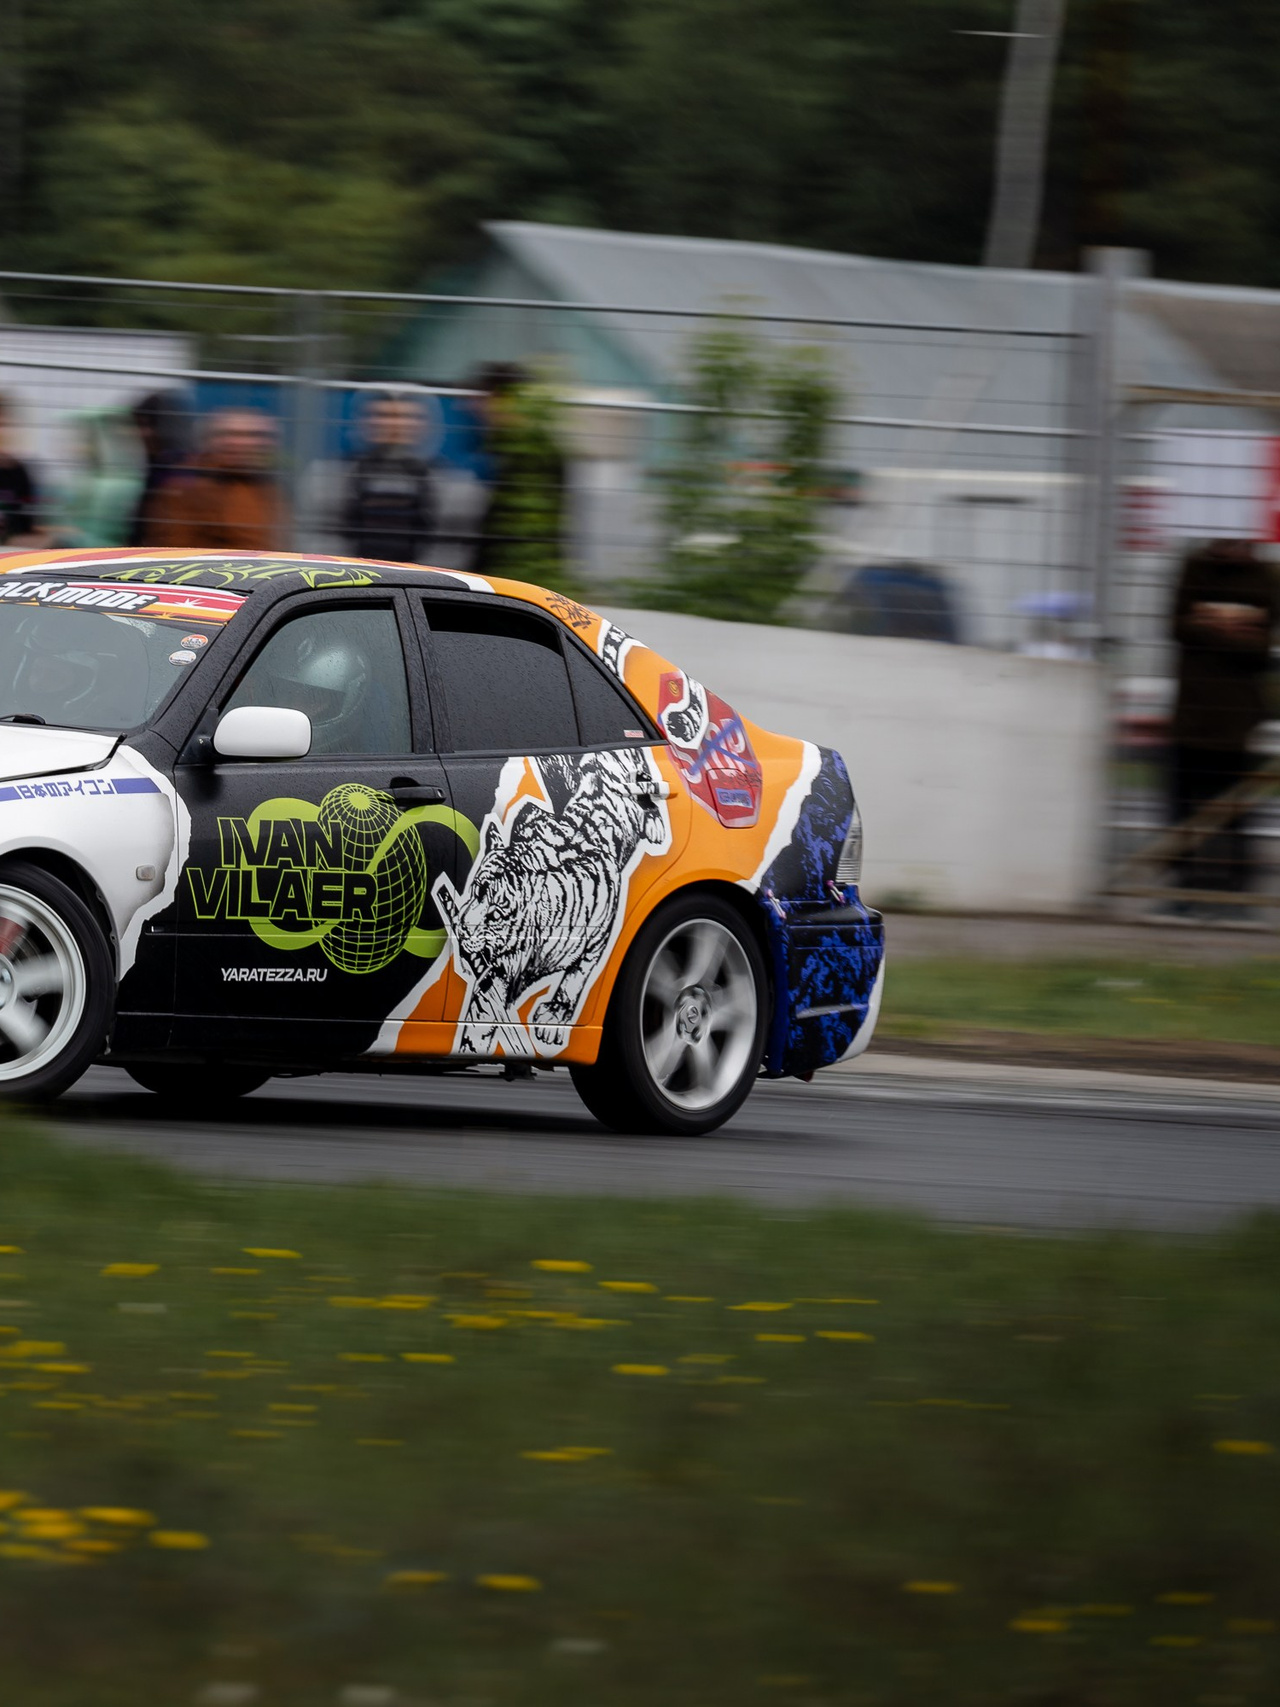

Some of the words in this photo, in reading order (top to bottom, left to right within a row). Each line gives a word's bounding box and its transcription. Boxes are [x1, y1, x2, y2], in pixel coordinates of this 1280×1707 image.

[16, 779, 115, 799] 日本のアイコン
[216, 816, 345, 871] IVAN
[186, 867, 379, 922] VILAER
[220, 967, 328, 982] YARATEZZA.RU
